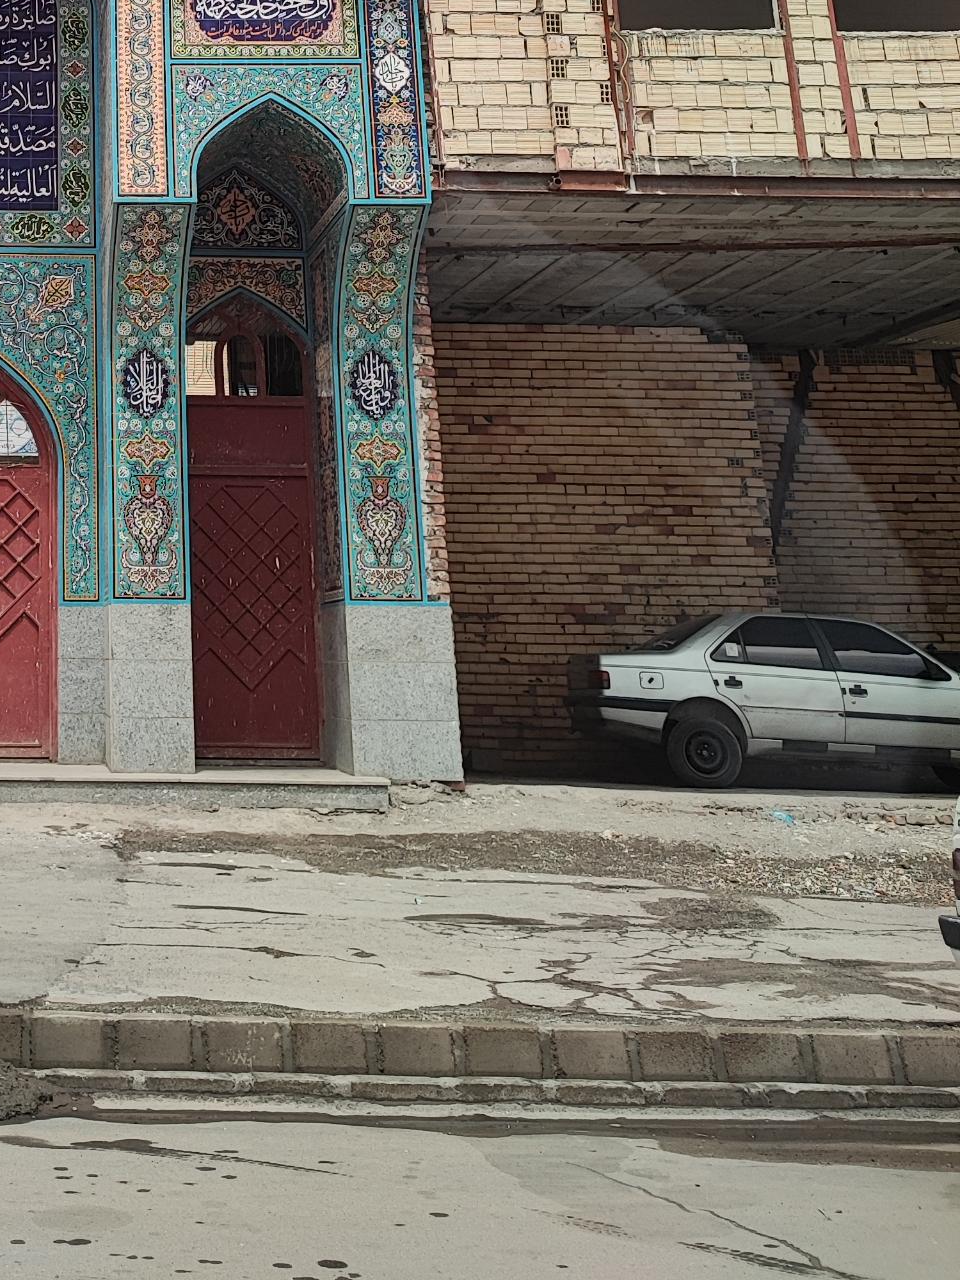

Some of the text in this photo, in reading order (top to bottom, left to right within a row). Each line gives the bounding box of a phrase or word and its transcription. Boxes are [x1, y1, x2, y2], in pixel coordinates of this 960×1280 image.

[17, 35, 57, 71] ابوك
[0, 80, 57, 113] السلام
[11, 165, 58, 203] العالية
